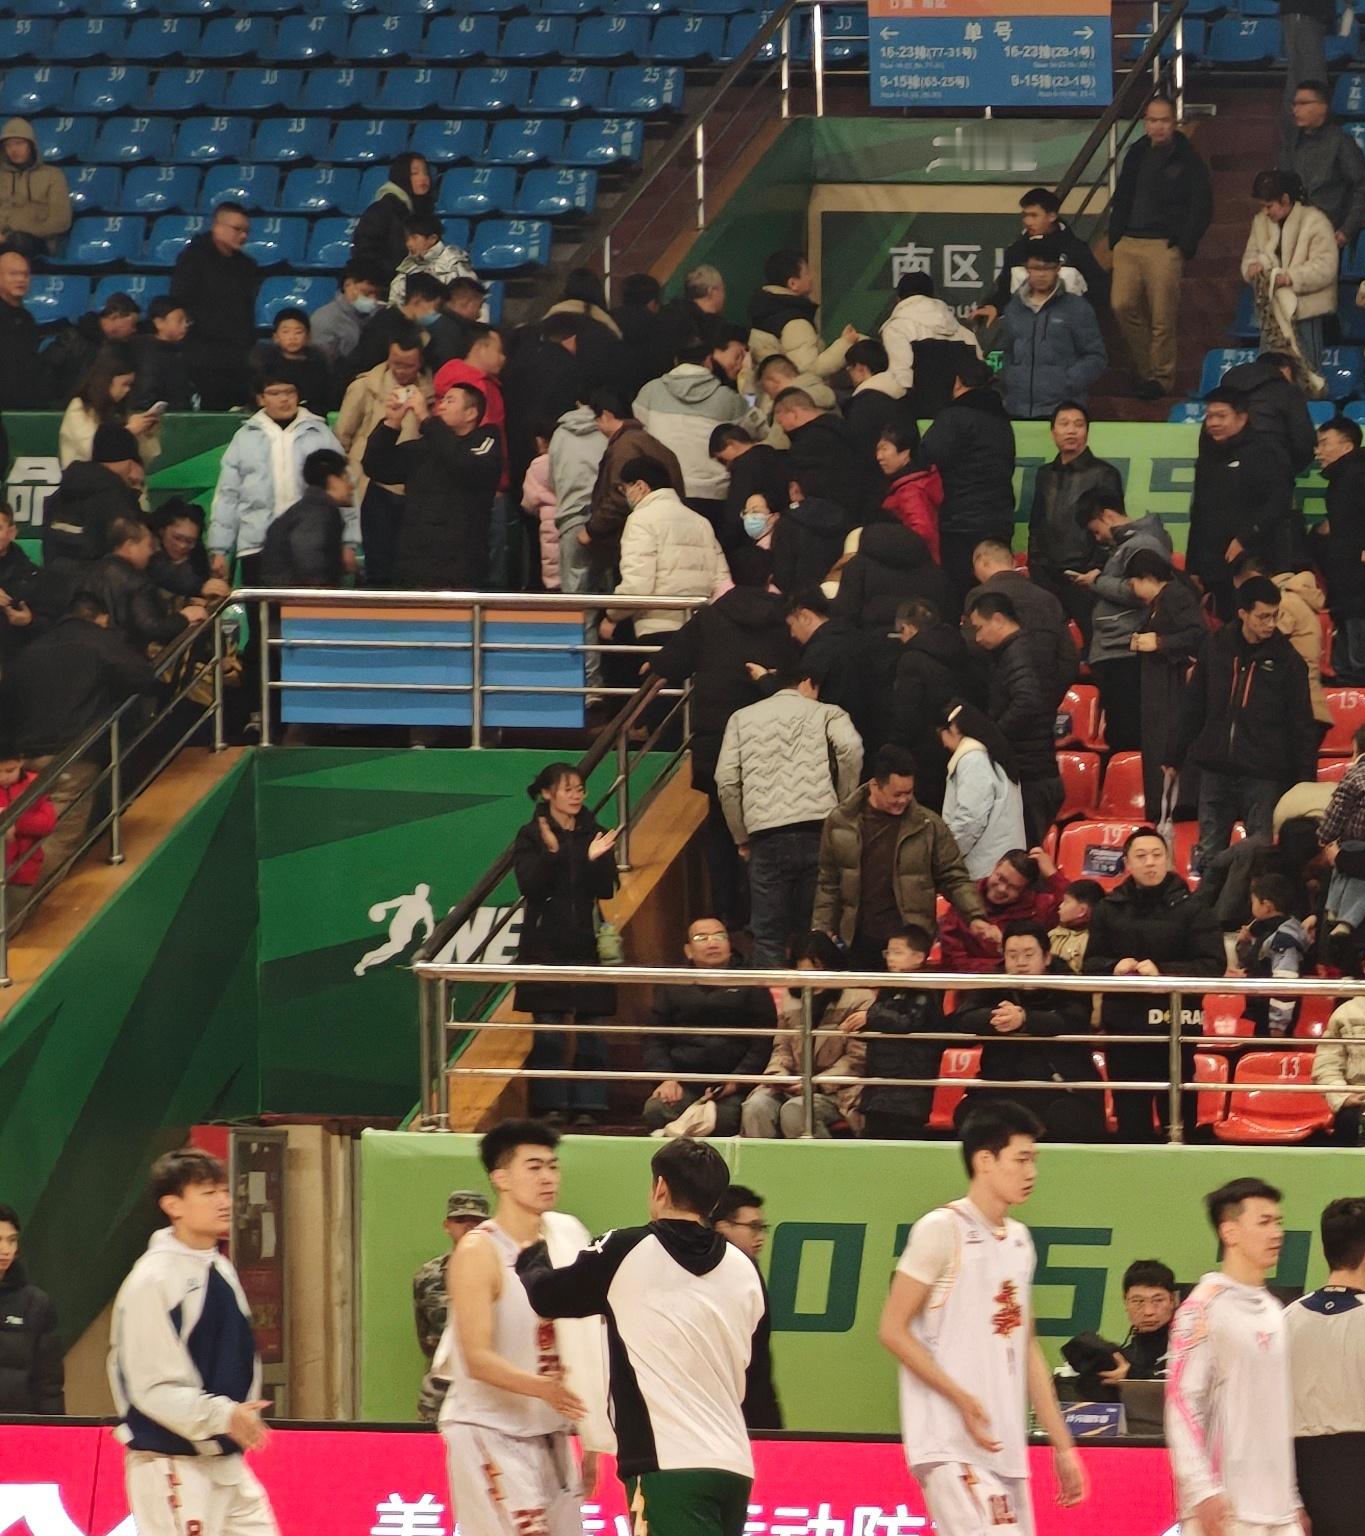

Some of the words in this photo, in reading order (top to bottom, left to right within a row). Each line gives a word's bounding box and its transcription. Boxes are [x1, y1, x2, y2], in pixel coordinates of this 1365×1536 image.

[1101, 825, 1123, 845] 19
[948, 1048, 973, 1073] 19
[1278, 1056, 1301, 1080] 13
